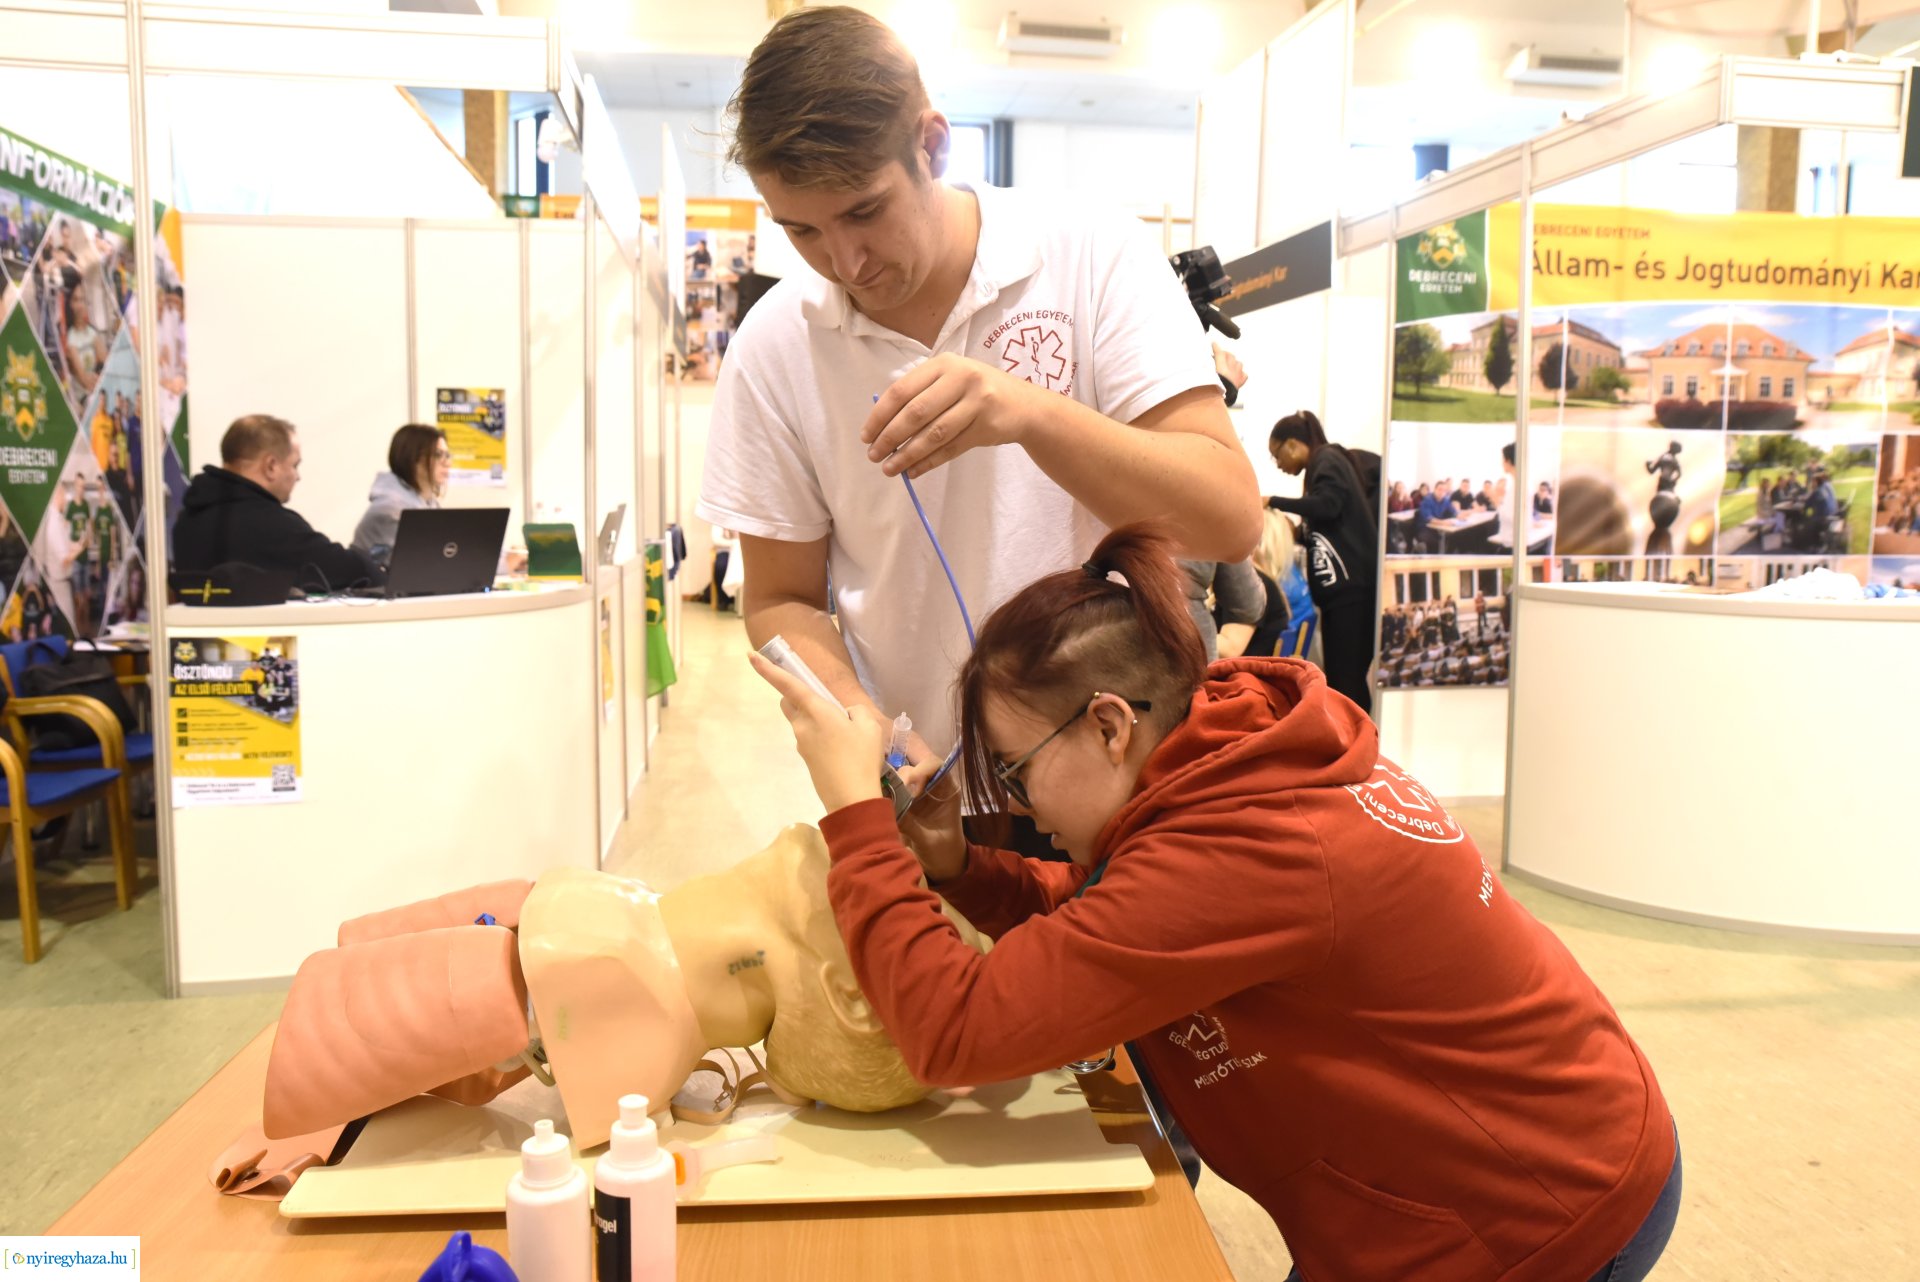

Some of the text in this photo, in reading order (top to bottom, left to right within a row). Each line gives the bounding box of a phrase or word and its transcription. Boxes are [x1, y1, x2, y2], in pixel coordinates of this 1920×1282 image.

[1534, 224, 1650, 239] EBRECENI EGYETEM
[1409, 269, 1476, 284] DEBRECENI
[1635, 250, 1666, 280] és
[1676, 255, 1872, 293] Jogtudományi
[984, 311, 1033, 349] DEBRECENI
[1364, 792, 1445, 836] Debreceni
